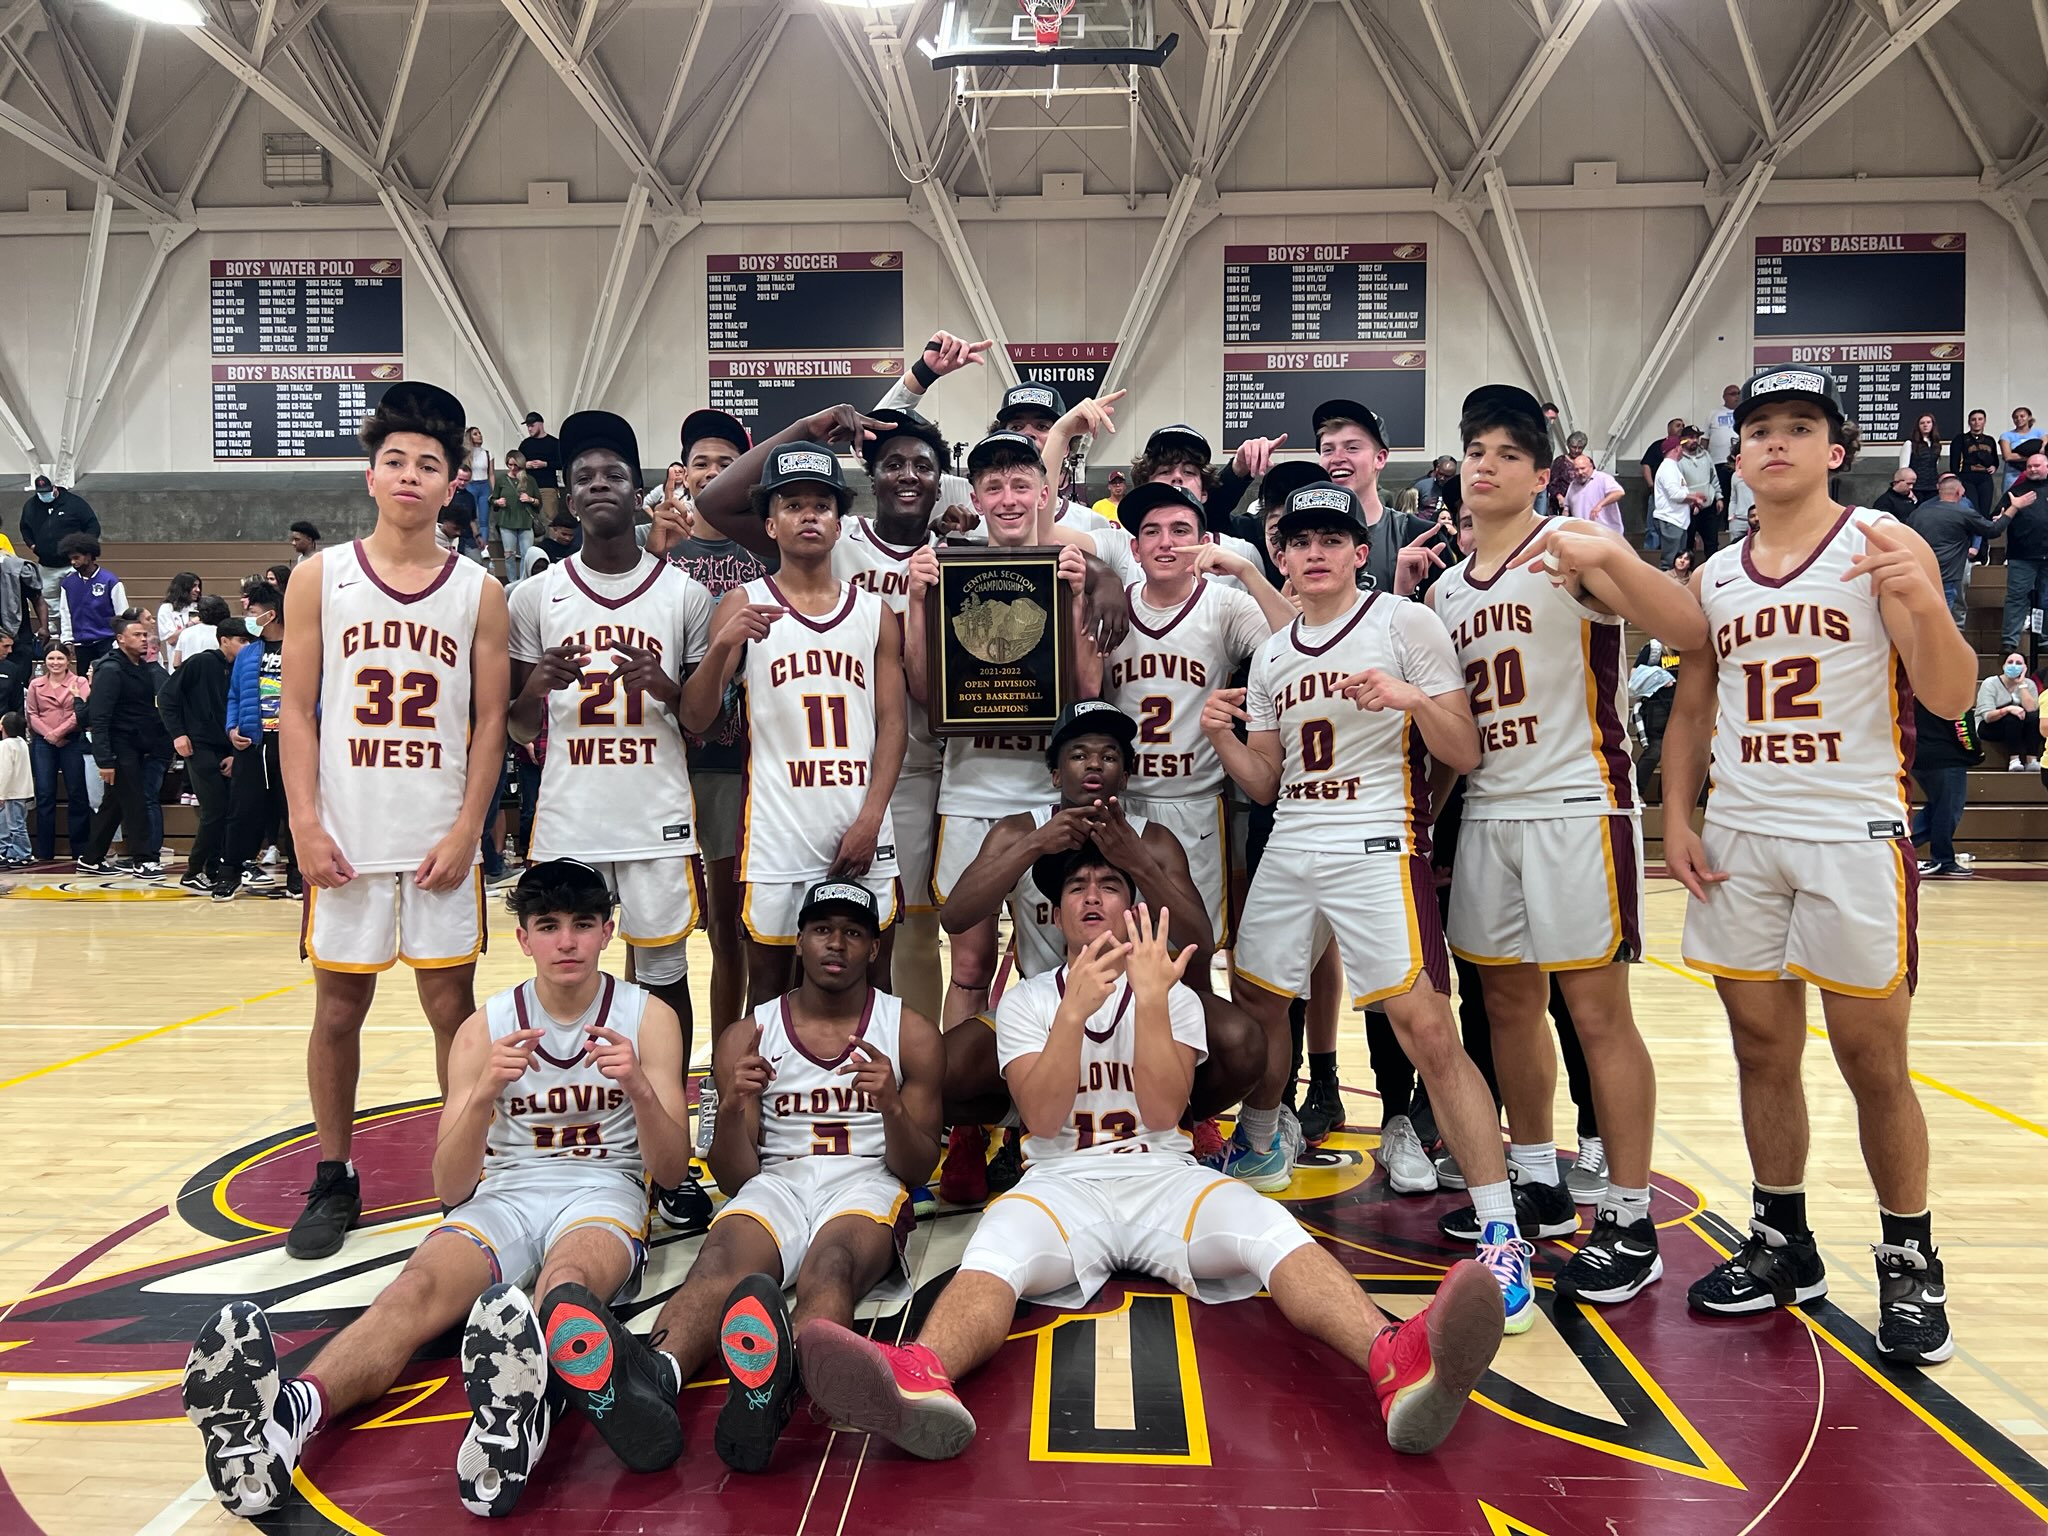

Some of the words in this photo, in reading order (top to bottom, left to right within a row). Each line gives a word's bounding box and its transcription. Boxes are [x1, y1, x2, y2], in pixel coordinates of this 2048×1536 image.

[1268, 247, 1309, 261] BOYS'
[1314, 246, 1349, 260] GOLF
[1783, 238, 1825, 252] BOYS'
[1831, 237, 1904, 251] BASEBALL
[226, 262, 264, 275] BOYS'
[270, 262, 315, 275] WATER
[320, 261, 353, 274] POLO
[739, 256, 779, 270] BOYS'
[784, 255, 837, 269] SOCCER
[1015, 347, 1108, 357] WELCOME
[1268, 355, 1308, 369] BOYS'
[1314, 354, 1348, 368] GOLF
[1792, 348, 1835, 361] BOYS'
[1841, 346, 1892, 360] TENNIS
[228, 367, 266, 380] BOYS'
[272, 366, 355, 379] BASKETBALL
[730, 362, 770, 376] BOYS'
[774, 361, 851, 375] WRESTLING
[1029, 368, 1094, 381] VISITORS
[852, 570, 909, 595] CLOV
[963, 570, 998, 593] CENTRAL
[1001, 570, 1036, 593] SECTION
[974, 581, 1024, 592] CHAMPIONSHIPS
[343, 620, 458, 668] CLOVIS
[1717, 603, 1851, 660] CLOVIS
[771, 650, 866, 689] CLOVIS
[1111, 653, 1206, 689] CLOVIS
[1465, 646, 1527, 715] 20
[354, 666, 440, 730] 32
[578, 670, 644, 727] 21
[1742, 654, 1822, 723] 12
[801, 693, 849, 749] 11
[974, 705, 1028, 713] CHAMPIONS
[1139, 695, 1175, 744] 2
[348, 738, 444, 769] WEST
[567, 738, 657, 766] WEST
[1300, 717, 1335, 772] 0
[1740, 731, 1842, 765] WEST
[787, 760, 867, 788] WEST
[1286, 777, 1360, 800] WEST
[1077, 1061, 1135, 1094] LOVI
[510, 1085, 624, 1116] CLOVIS
[1073, 1109, 1138, 1151] 13
